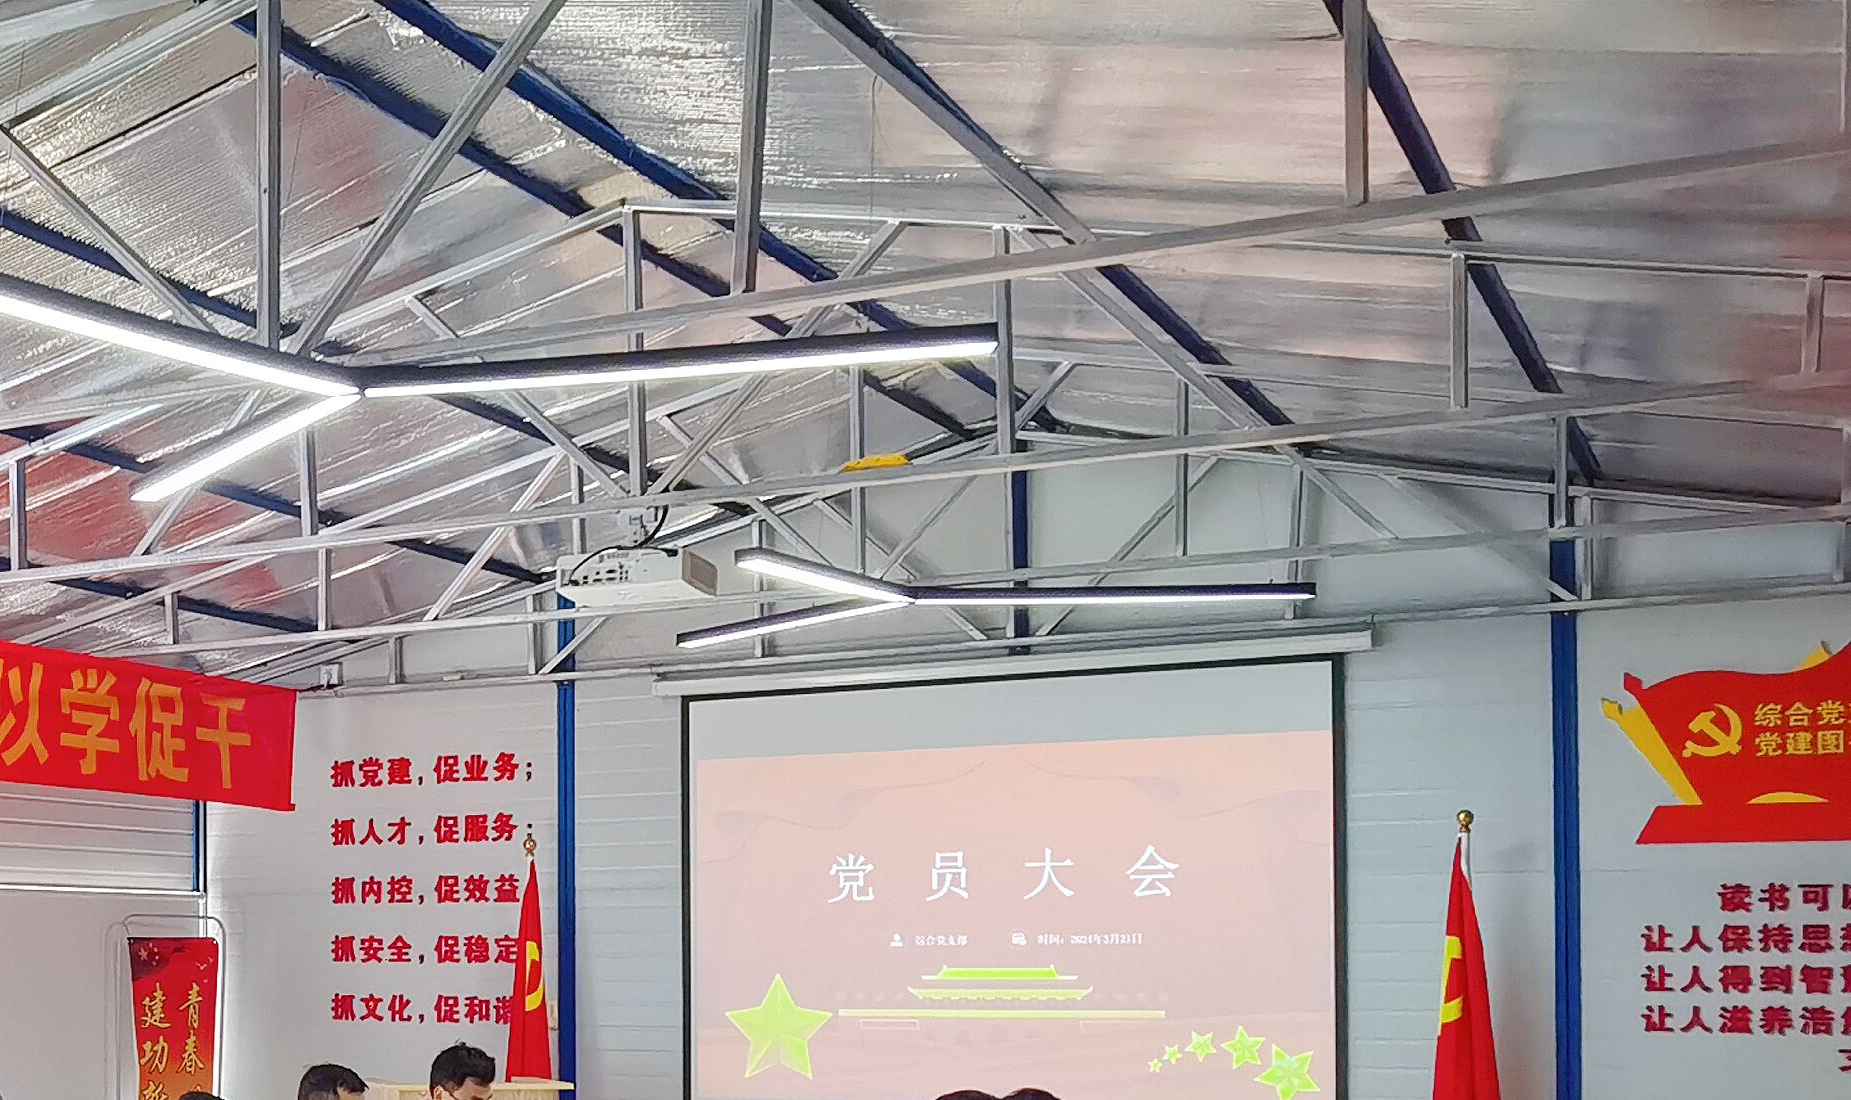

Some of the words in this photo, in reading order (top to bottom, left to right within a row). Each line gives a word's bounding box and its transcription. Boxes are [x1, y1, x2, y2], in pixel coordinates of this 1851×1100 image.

[1754, 699, 1851, 728] 综合党
[1754, 729, 1851, 757] 党建图
[827, 844, 1180, 903] 党员大会
[1717, 882, 1851, 912] 读书可
[1640, 923, 1851, 954] 让人保持思
[1640, 964, 1851, 994] 让人得到智
[1640, 1004, 1851, 1036] 让人滋养浩
[177, 982, 205, 1092] 青春
